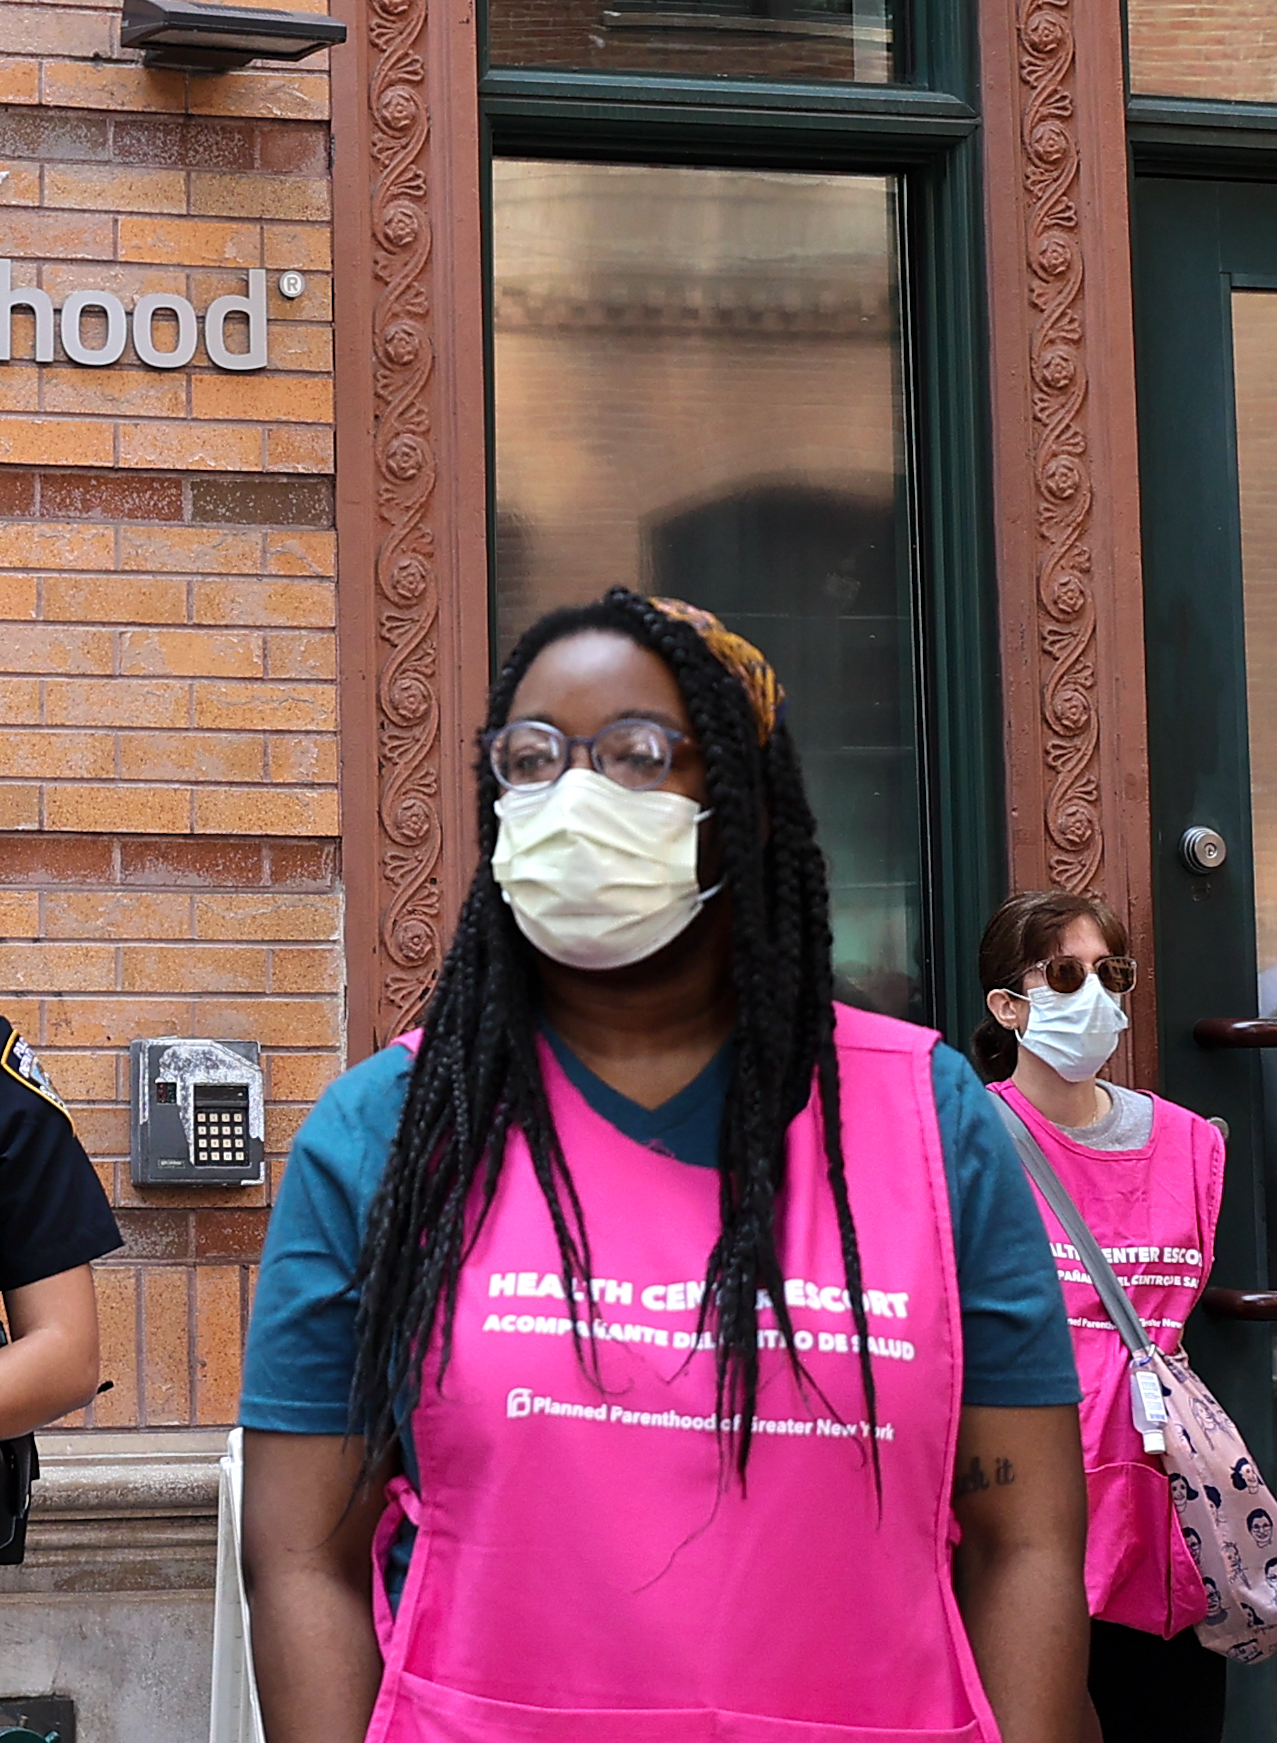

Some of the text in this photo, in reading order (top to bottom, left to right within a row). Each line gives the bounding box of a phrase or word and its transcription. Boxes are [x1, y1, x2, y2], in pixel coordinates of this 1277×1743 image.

[818, 1332, 849, 1353] DE
[532, 1396, 608, 1421] Planned
[610, 1405, 717, 1432] Parenthood
[816, 1418, 857, 1437] New
